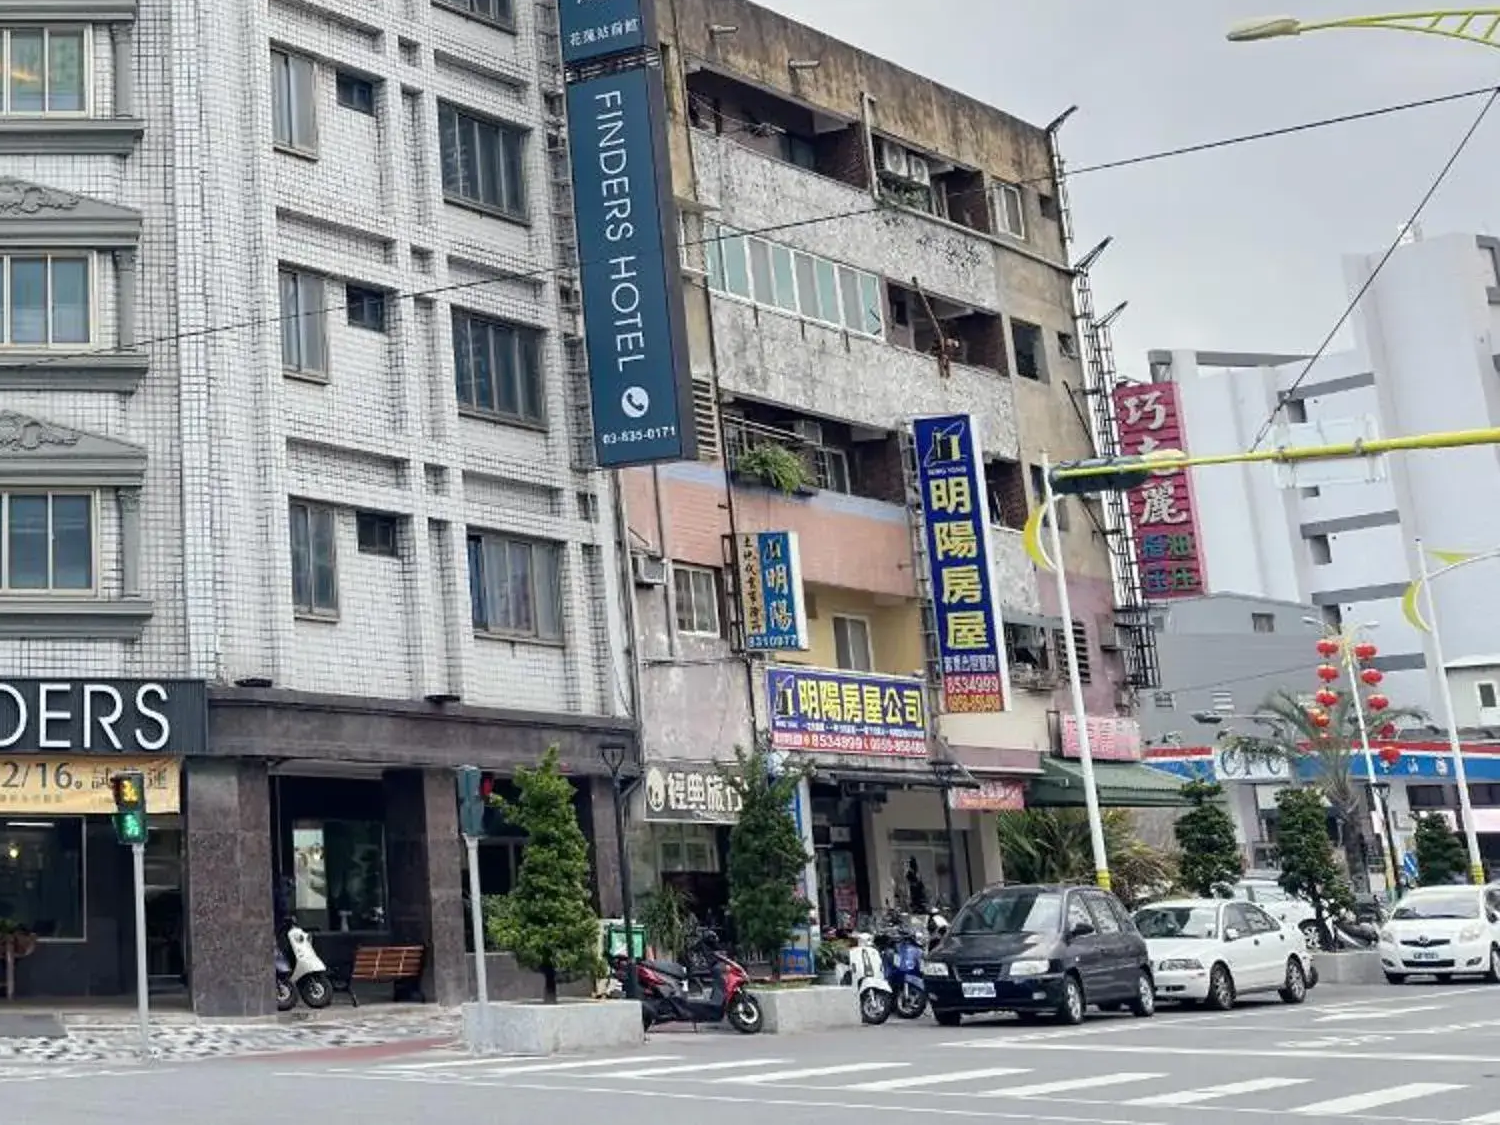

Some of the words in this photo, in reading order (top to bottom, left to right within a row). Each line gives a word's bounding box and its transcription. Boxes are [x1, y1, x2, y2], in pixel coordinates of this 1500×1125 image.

[595, 90, 635, 243] FINDERS
[609, 255, 646, 372] HOTEL
[602, 425, 676, 444] 03-835-0171
[765, 563, 793, 632] 明陽
[929, 477, 990, 650] 明陽房屋
[797, 679, 923, 728] 明陽房屋公司
